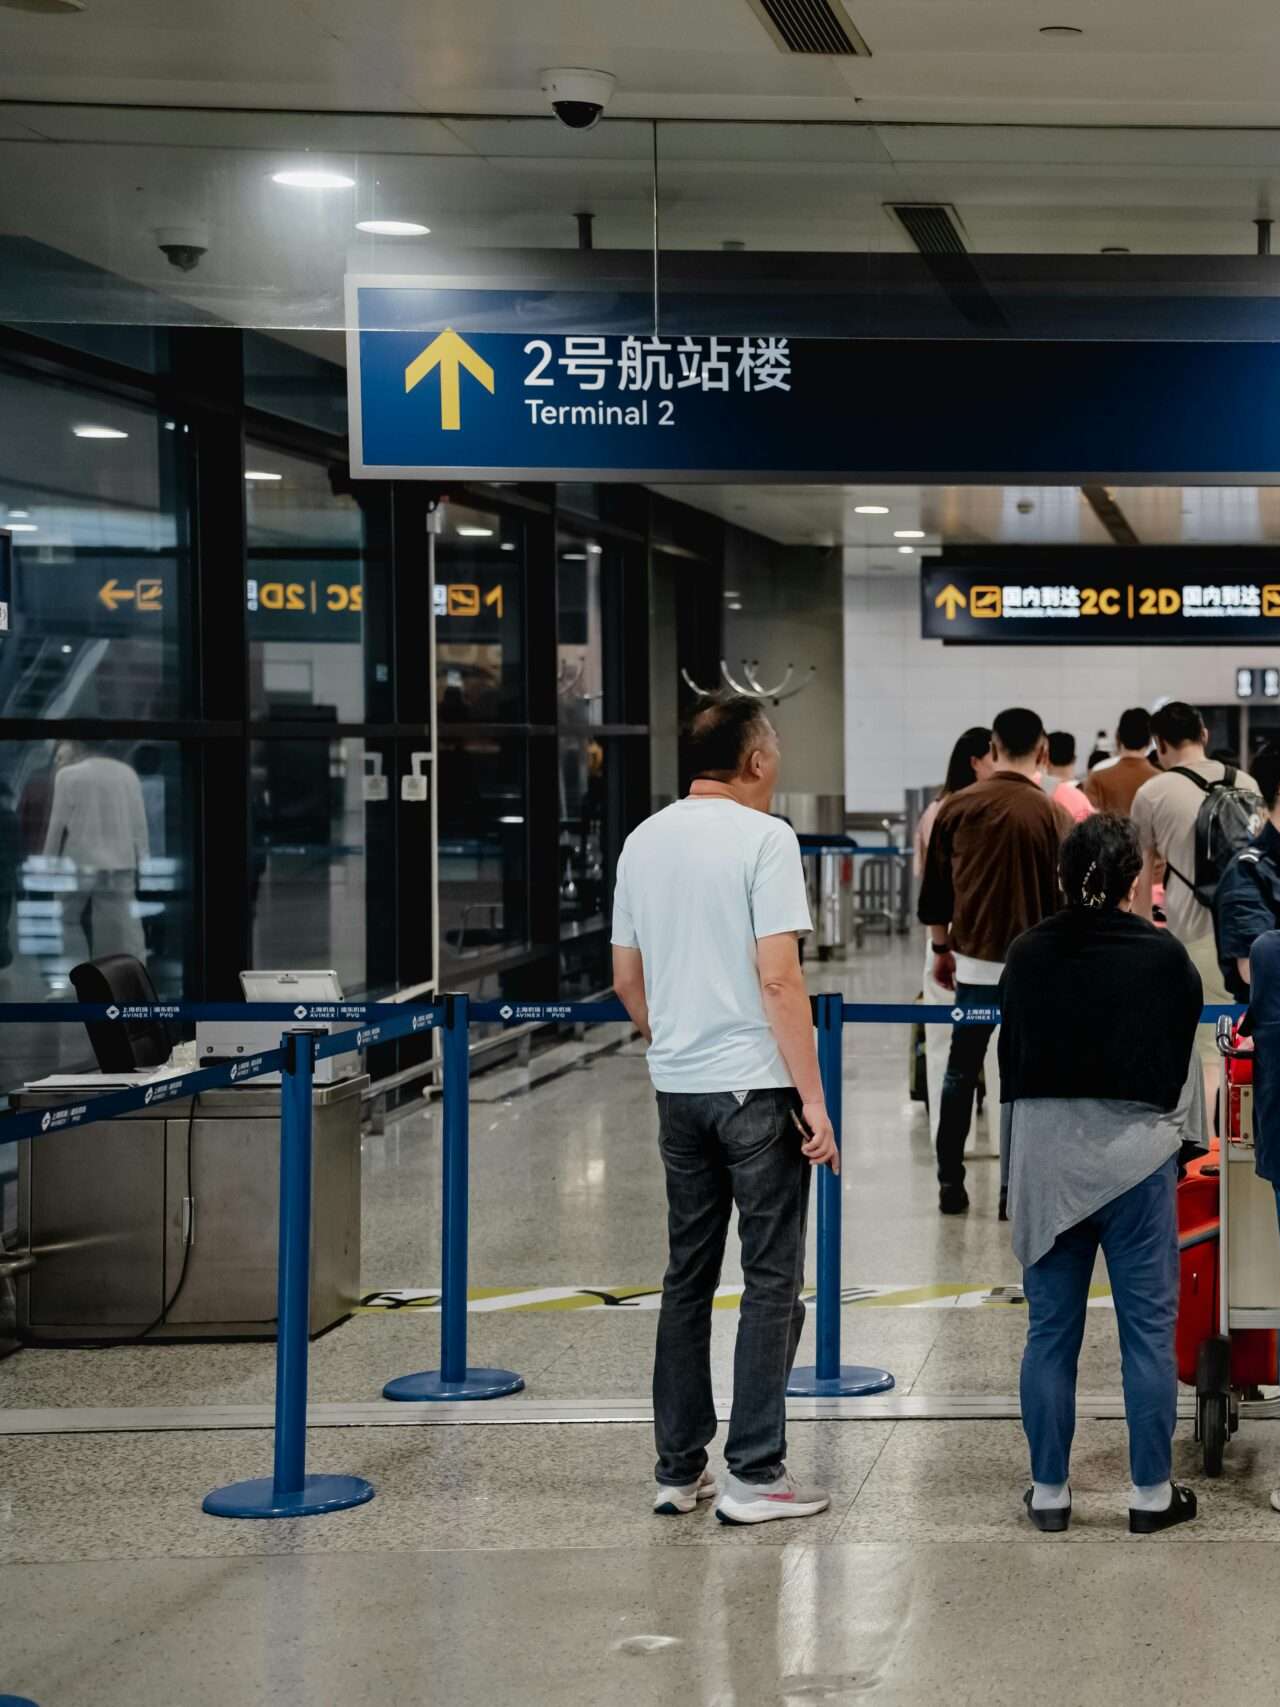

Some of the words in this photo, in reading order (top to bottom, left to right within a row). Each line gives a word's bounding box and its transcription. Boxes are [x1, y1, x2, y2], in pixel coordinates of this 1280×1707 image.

[523, 336, 792, 392] 2号航站楼
[524, 399, 648, 425] Terminal
[658, 400, 675, 425] 2
[1003, 586, 1081, 607] 国内到达
[1081, 588, 1120, 615] 2C
[1139, 588, 1181, 616] 2D
[1182, 585, 1261, 606] 国内到达
